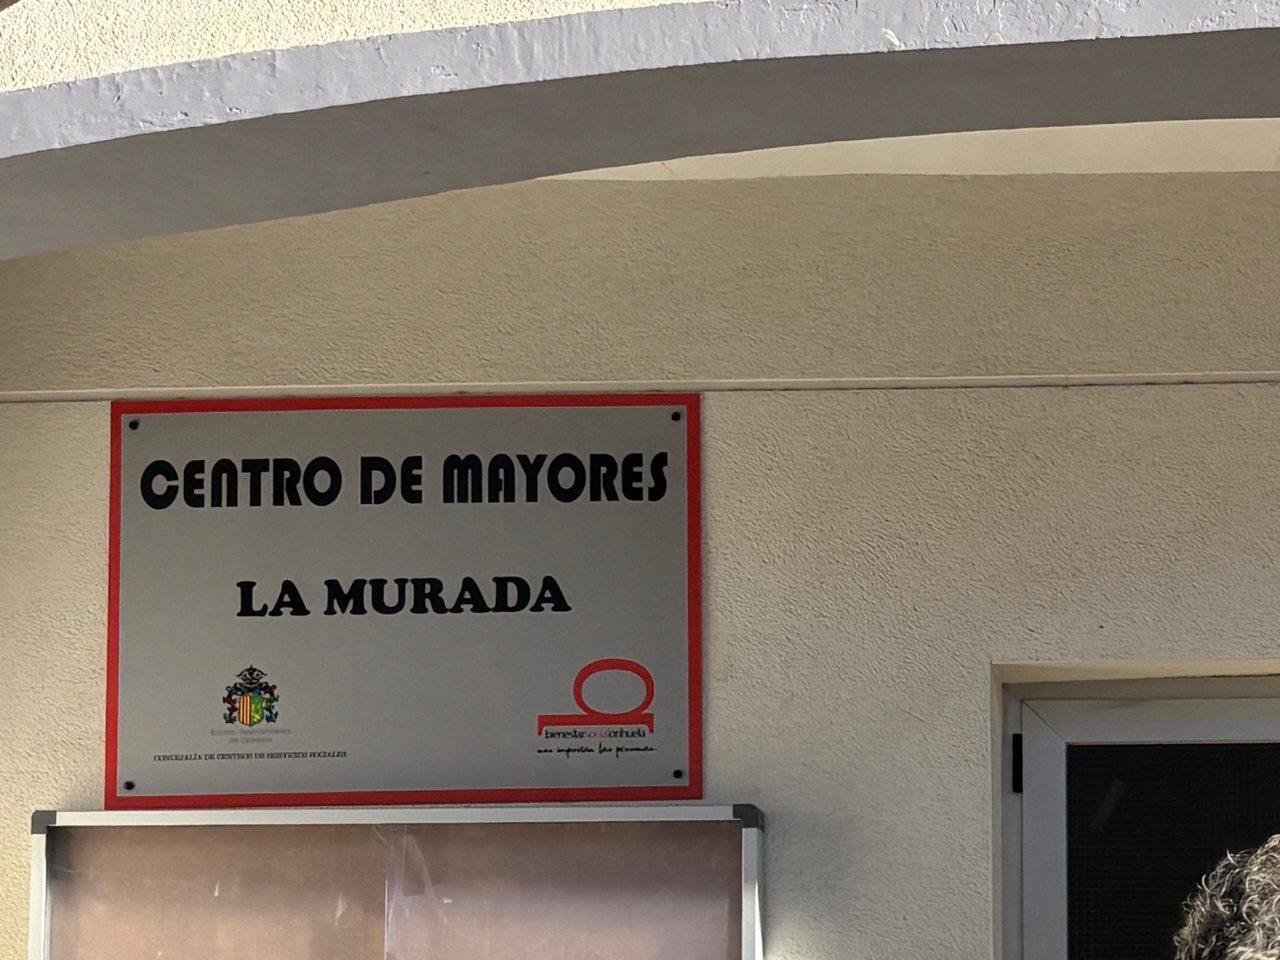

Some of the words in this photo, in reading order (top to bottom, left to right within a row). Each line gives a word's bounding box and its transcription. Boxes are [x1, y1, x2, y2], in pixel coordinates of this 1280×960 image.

[140, 456, 343, 510] CENTRO
[360, 455, 423, 505] DE
[443, 452, 669, 503] MAYORES
[236, 580, 311, 617] LA
[323, 575, 572, 615] MURADA
